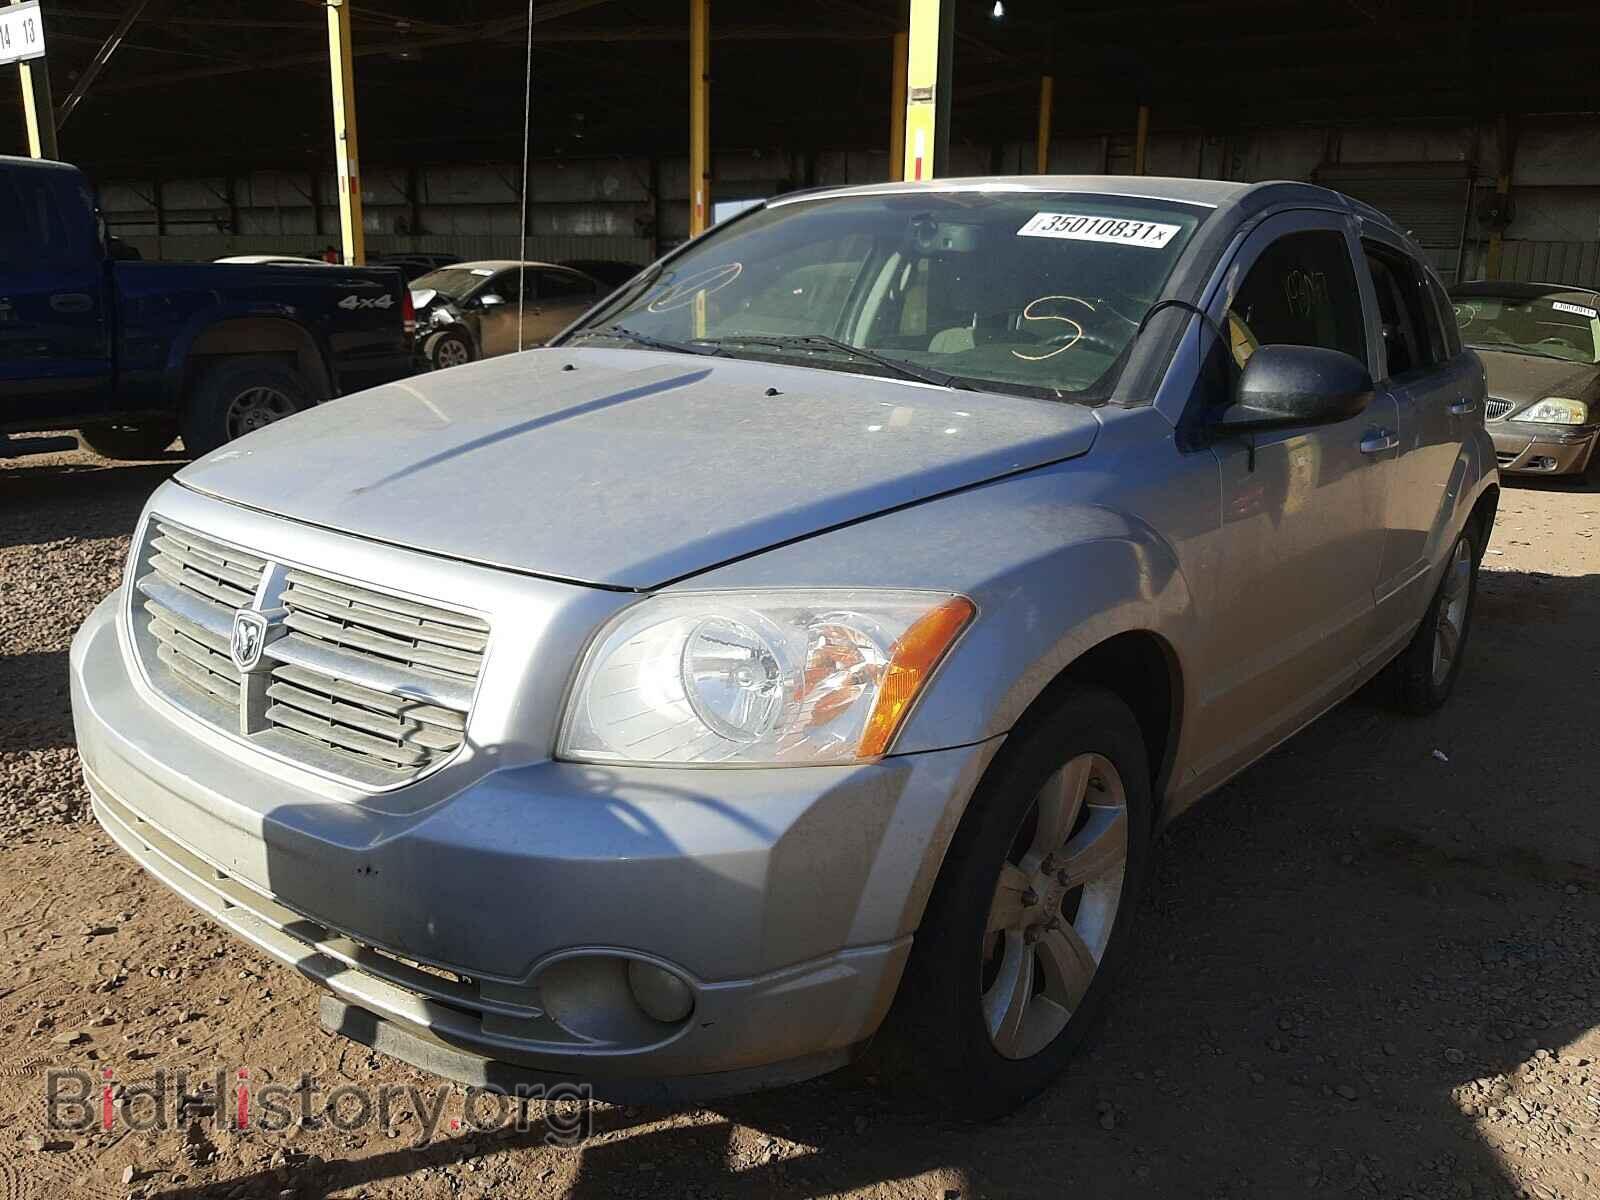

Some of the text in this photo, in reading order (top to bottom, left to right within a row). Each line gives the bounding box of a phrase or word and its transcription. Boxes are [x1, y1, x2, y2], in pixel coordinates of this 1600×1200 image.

[0, 18, 35, 49] 14 13
[337, 294, 395, 310] 4x4
